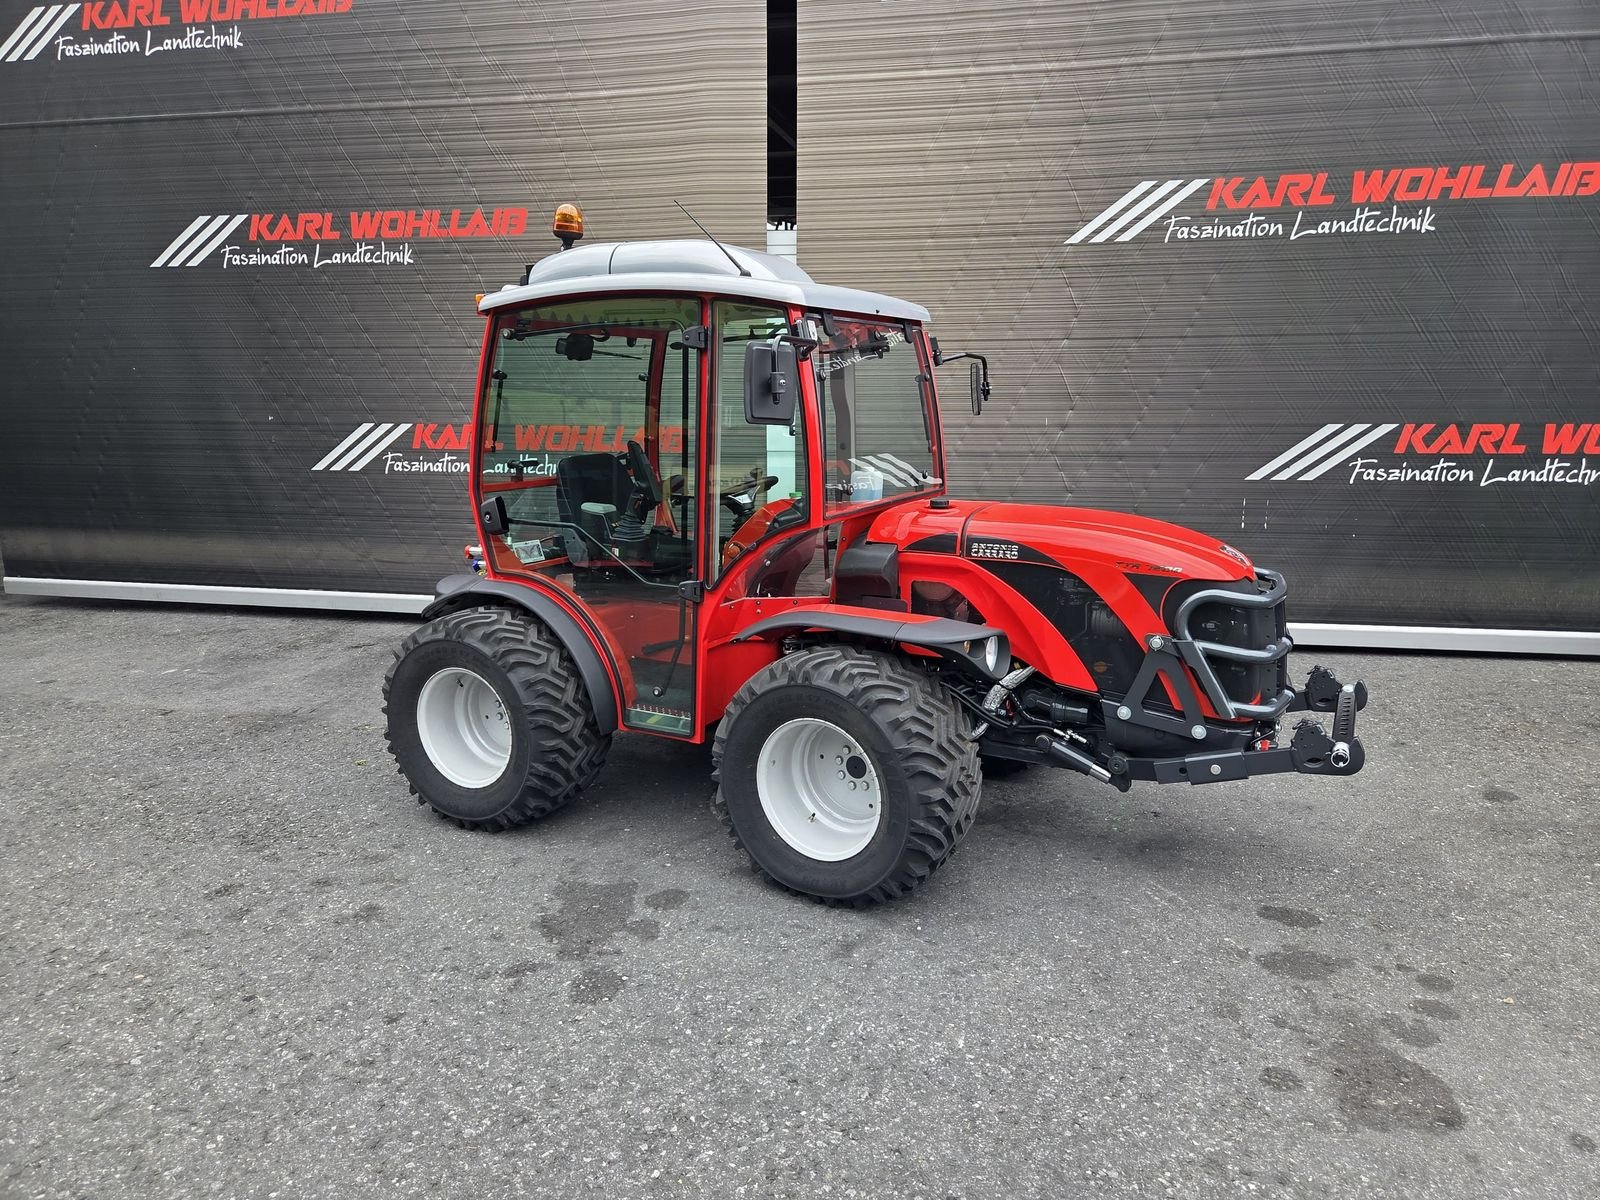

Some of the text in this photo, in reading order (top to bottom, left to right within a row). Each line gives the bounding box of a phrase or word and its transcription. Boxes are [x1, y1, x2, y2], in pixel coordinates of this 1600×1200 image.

[82, 0, 170, 31] KARL
[54, 25, 244, 60] Faszination Landtechnik
[1205, 172, 1335, 210] KARL
[249, 212, 341, 241] KARL
[1164, 205, 1436, 243] Faszination Landtechnik
[219, 242, 414, 269] Faszination Landtechnik
[1393, 423, 1527, 454] KARL
[382, 451, 471, 475] Faszination
[1349, 457, 1474, 485] Faszination
[971, 542, 1019, 551] ANTONIO
[971, 549, 1019, 559] CARRARO
